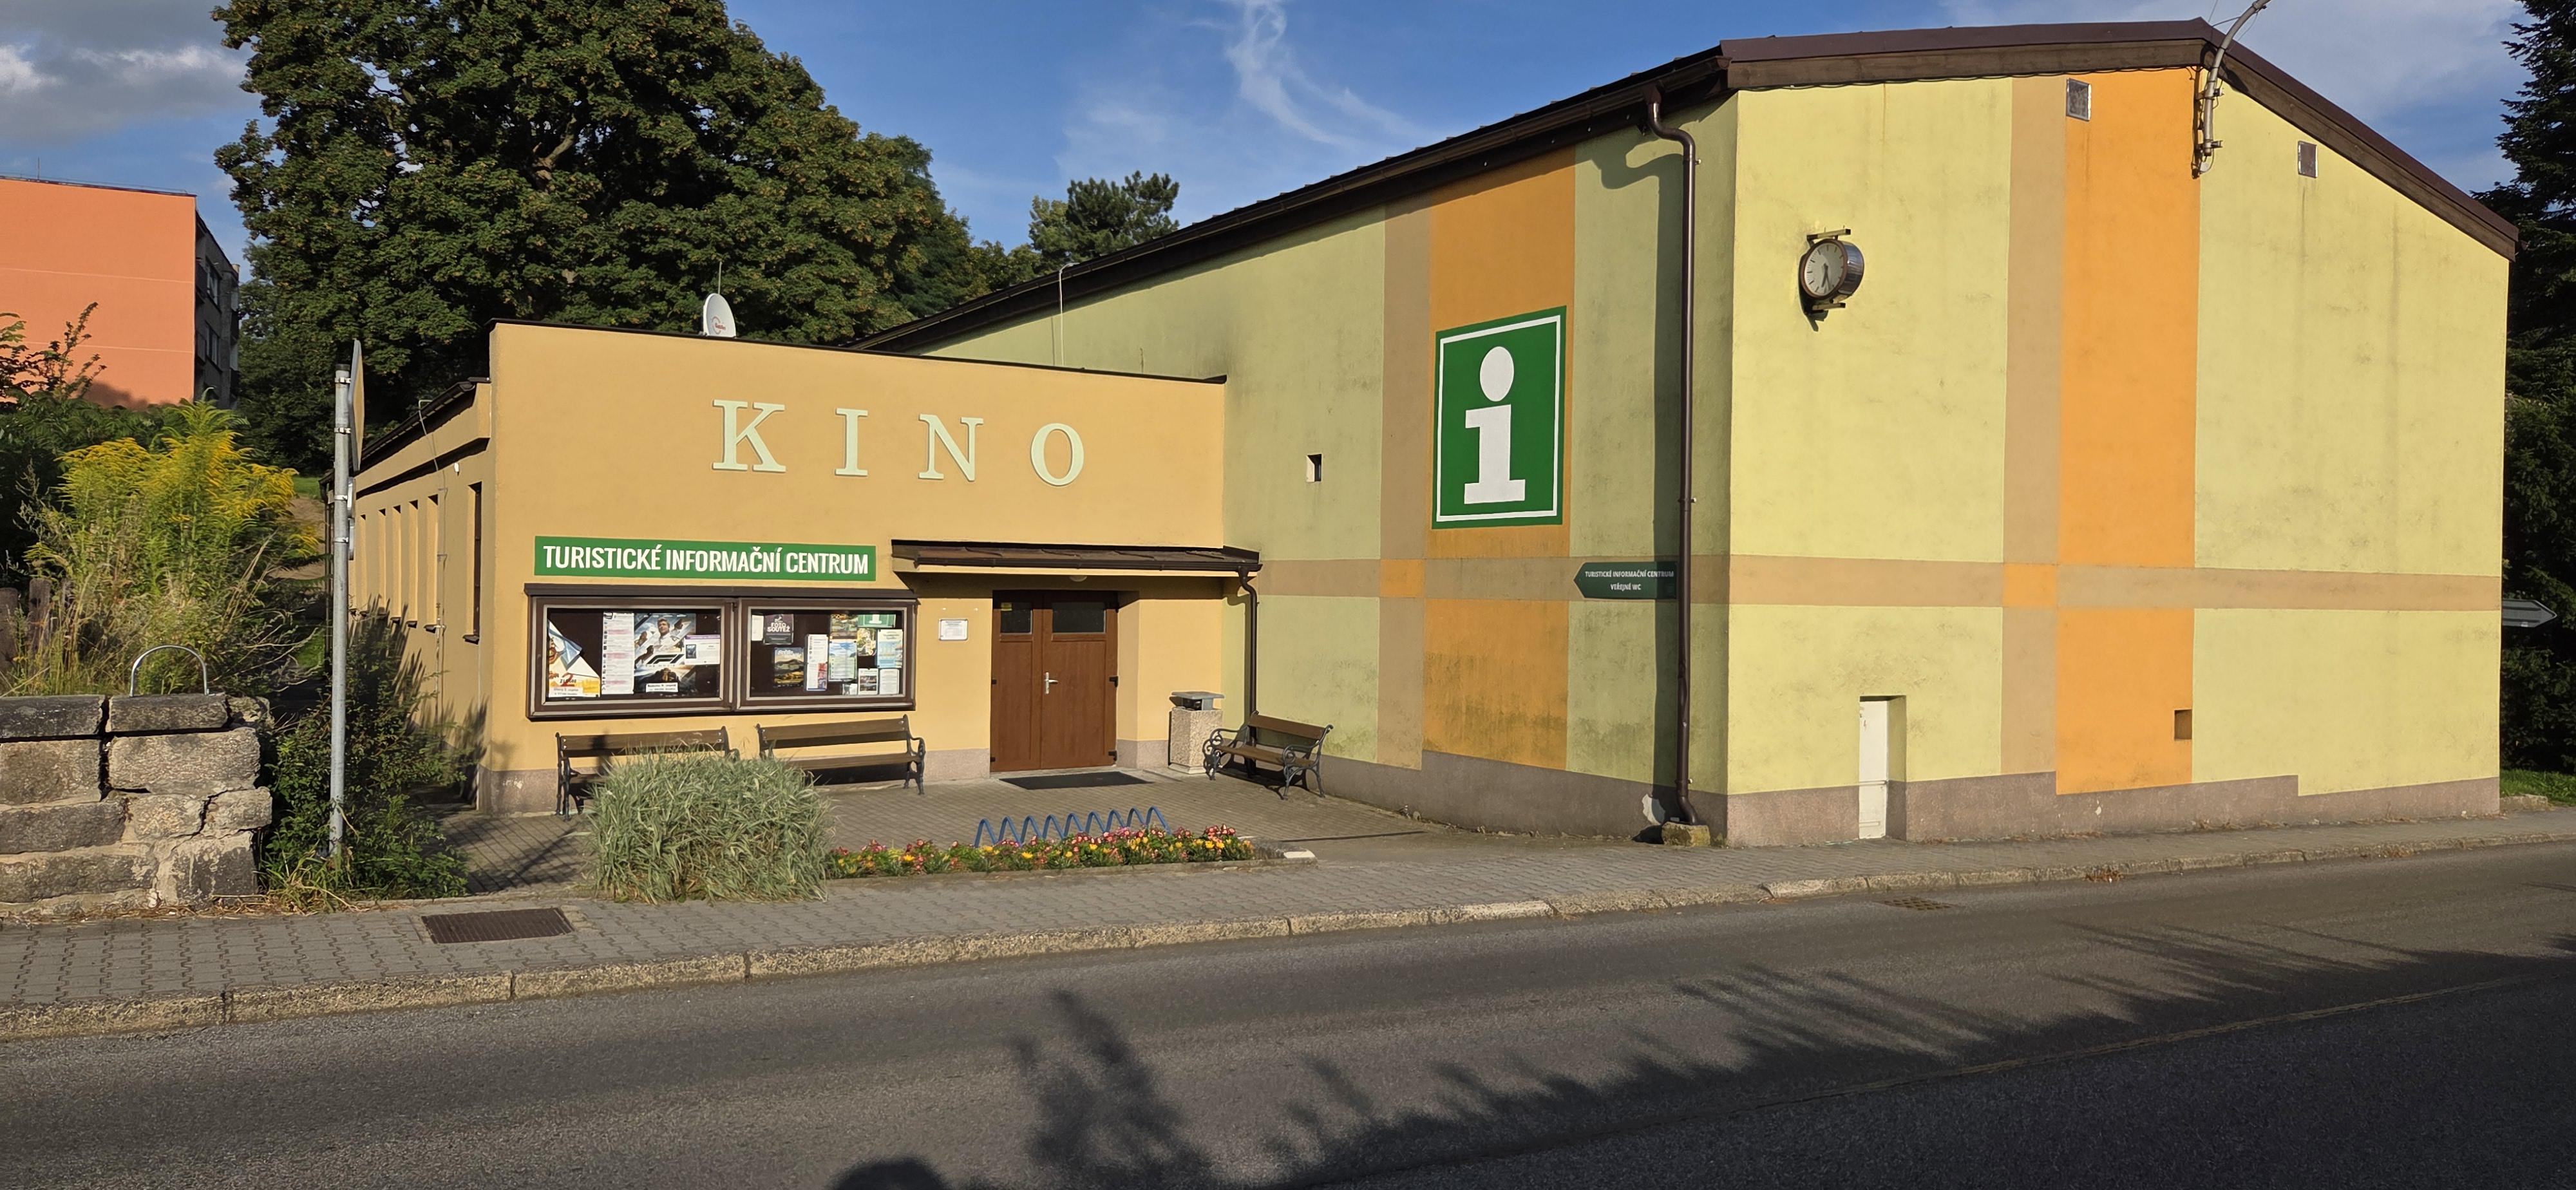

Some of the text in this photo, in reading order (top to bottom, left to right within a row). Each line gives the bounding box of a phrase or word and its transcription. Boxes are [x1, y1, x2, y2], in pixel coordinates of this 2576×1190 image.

[1464, 346, 1526, 504] i
[713, 399, 1084, 486] KINO
[543, 544, 868, 574] TURISTICKÉ INFORMAČNÍ CENTRUM
[1585, 569, 1612, 578] TURISTICKÉ
[1613, 569, 1647, 578] INFORMAČNÍ
[1610, 582, 1631, 592] VEŘEJNÉ
